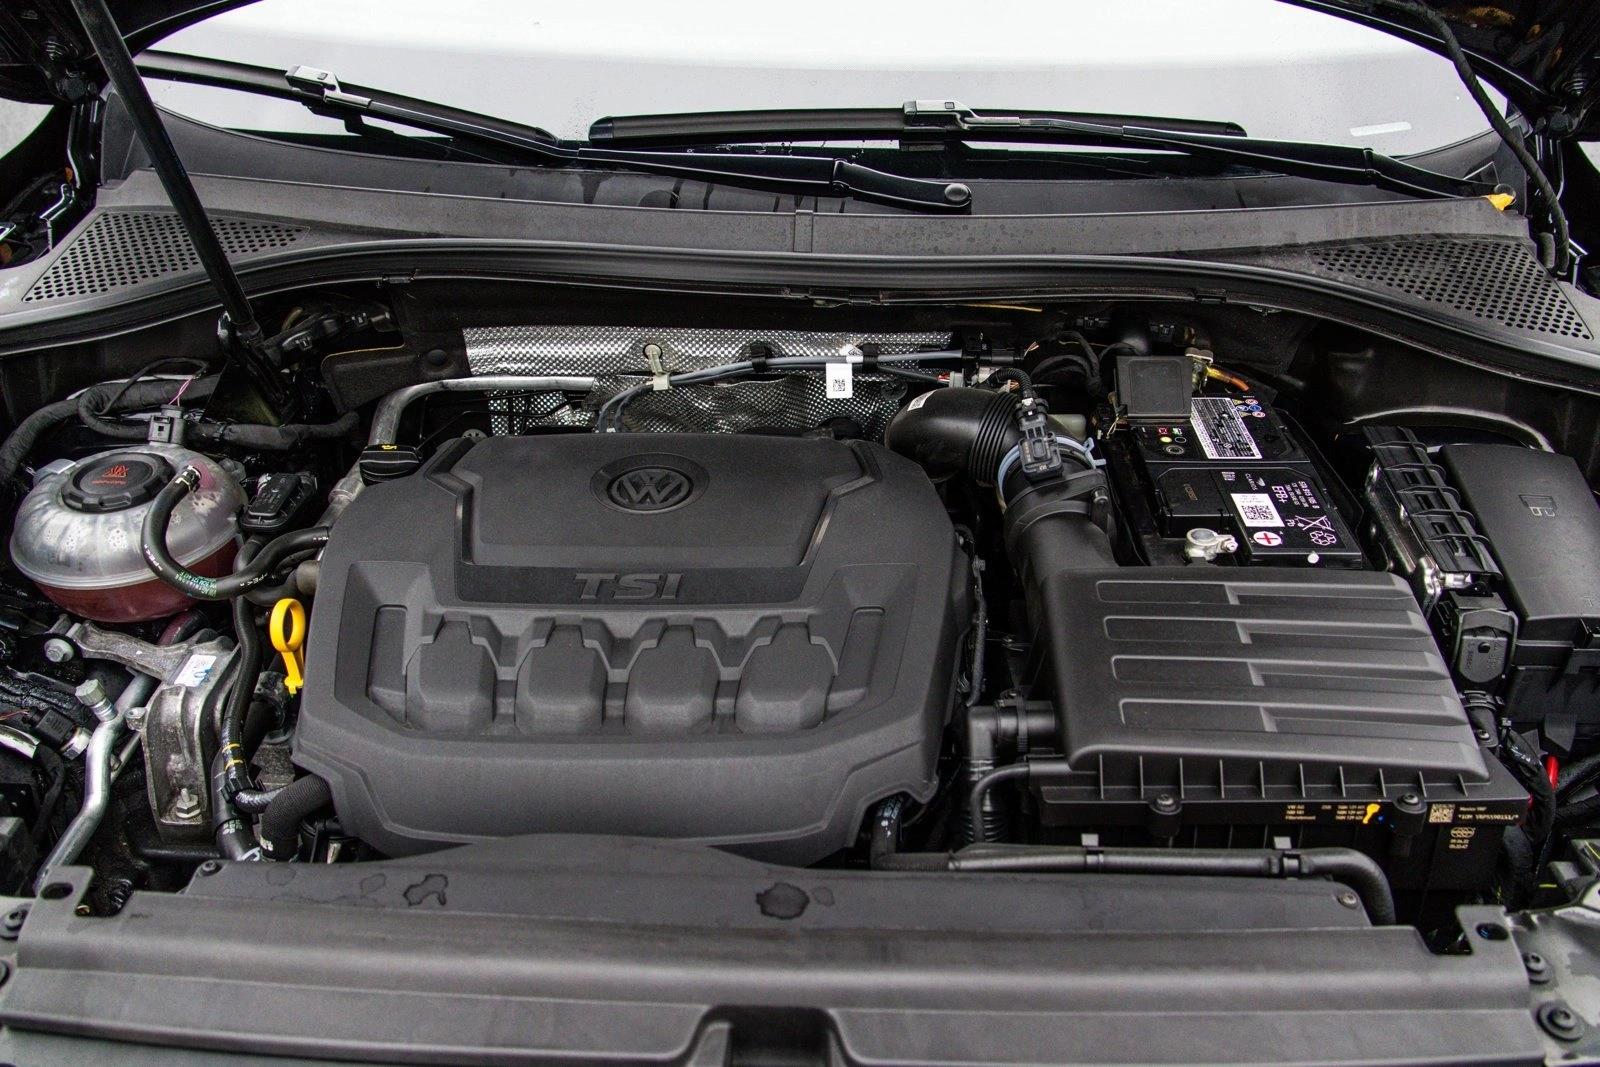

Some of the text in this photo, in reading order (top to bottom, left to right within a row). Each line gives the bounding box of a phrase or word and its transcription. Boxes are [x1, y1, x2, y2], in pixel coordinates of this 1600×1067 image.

[611, 468, 691, 511] VW
[1271, 485, 1289, 504] EFB+
[575, 572, 684, 600] TSI
